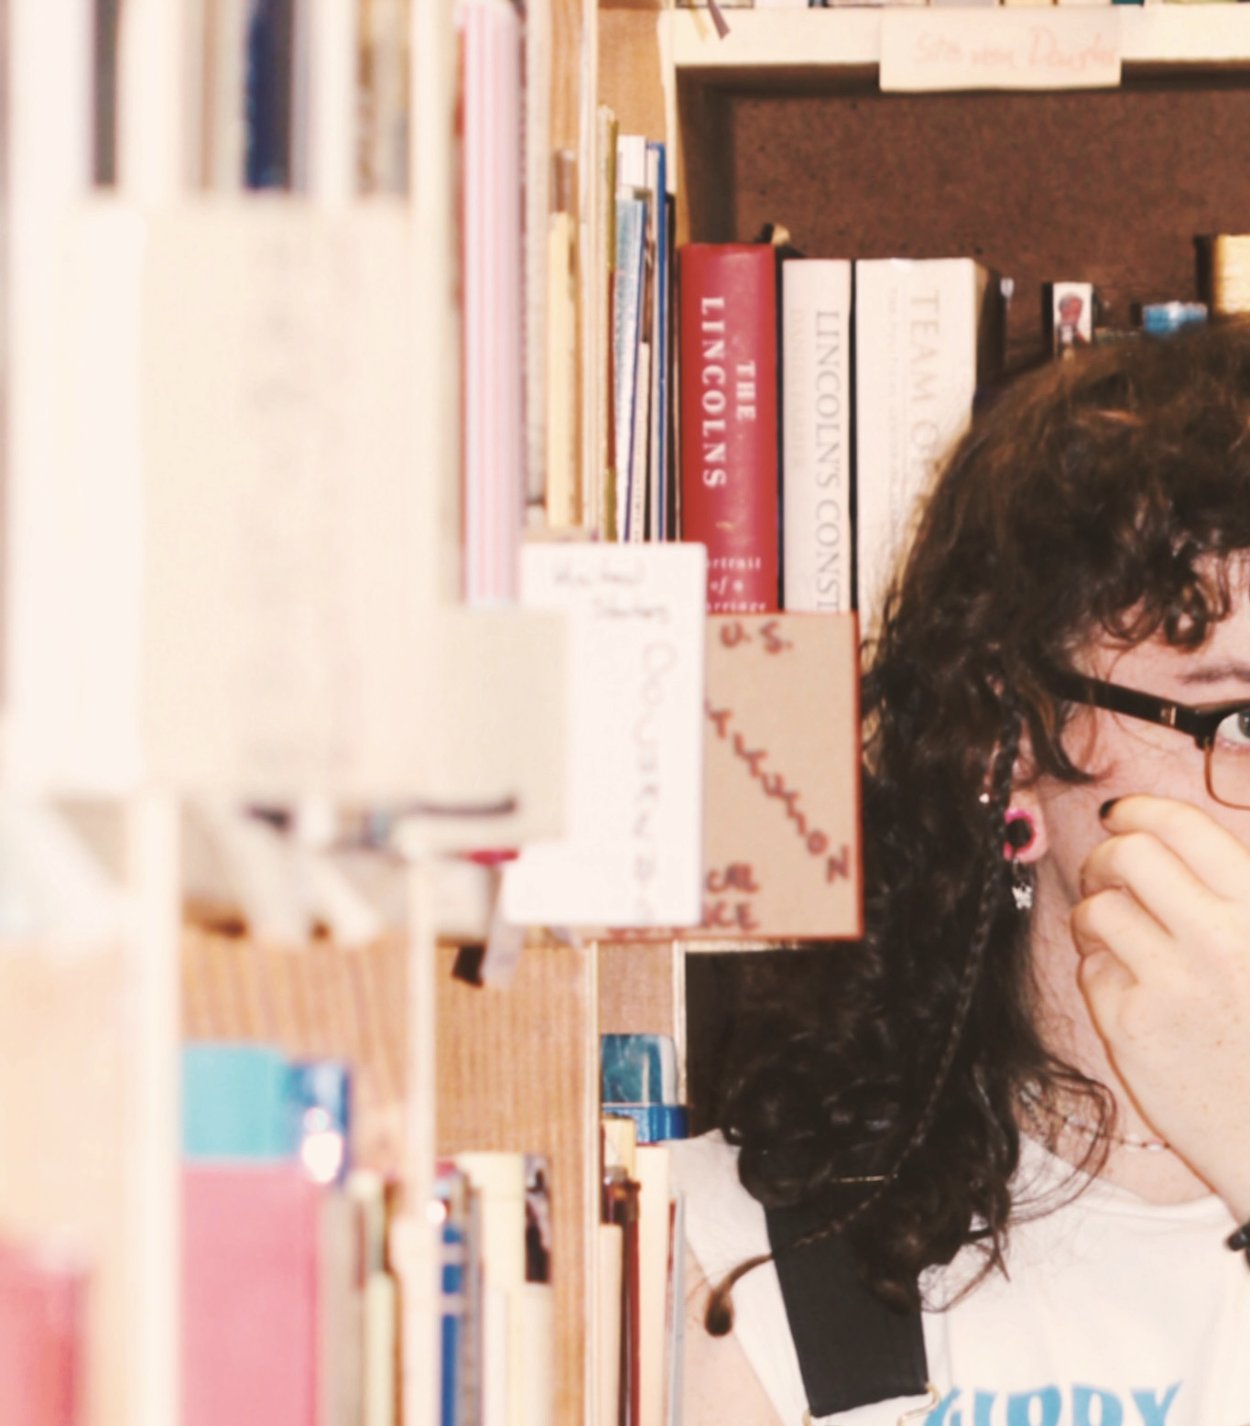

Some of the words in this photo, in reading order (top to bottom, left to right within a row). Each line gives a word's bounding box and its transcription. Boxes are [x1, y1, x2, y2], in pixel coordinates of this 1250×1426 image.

[701, 297, 728, 490] LINCOLNS
[735, 360, 757, 422] THE
[814, 310, 842, 491] LINCOLN'S
[910, 290, 939, 399] TEAM
[703, 698, 850, 884] TITUTION
